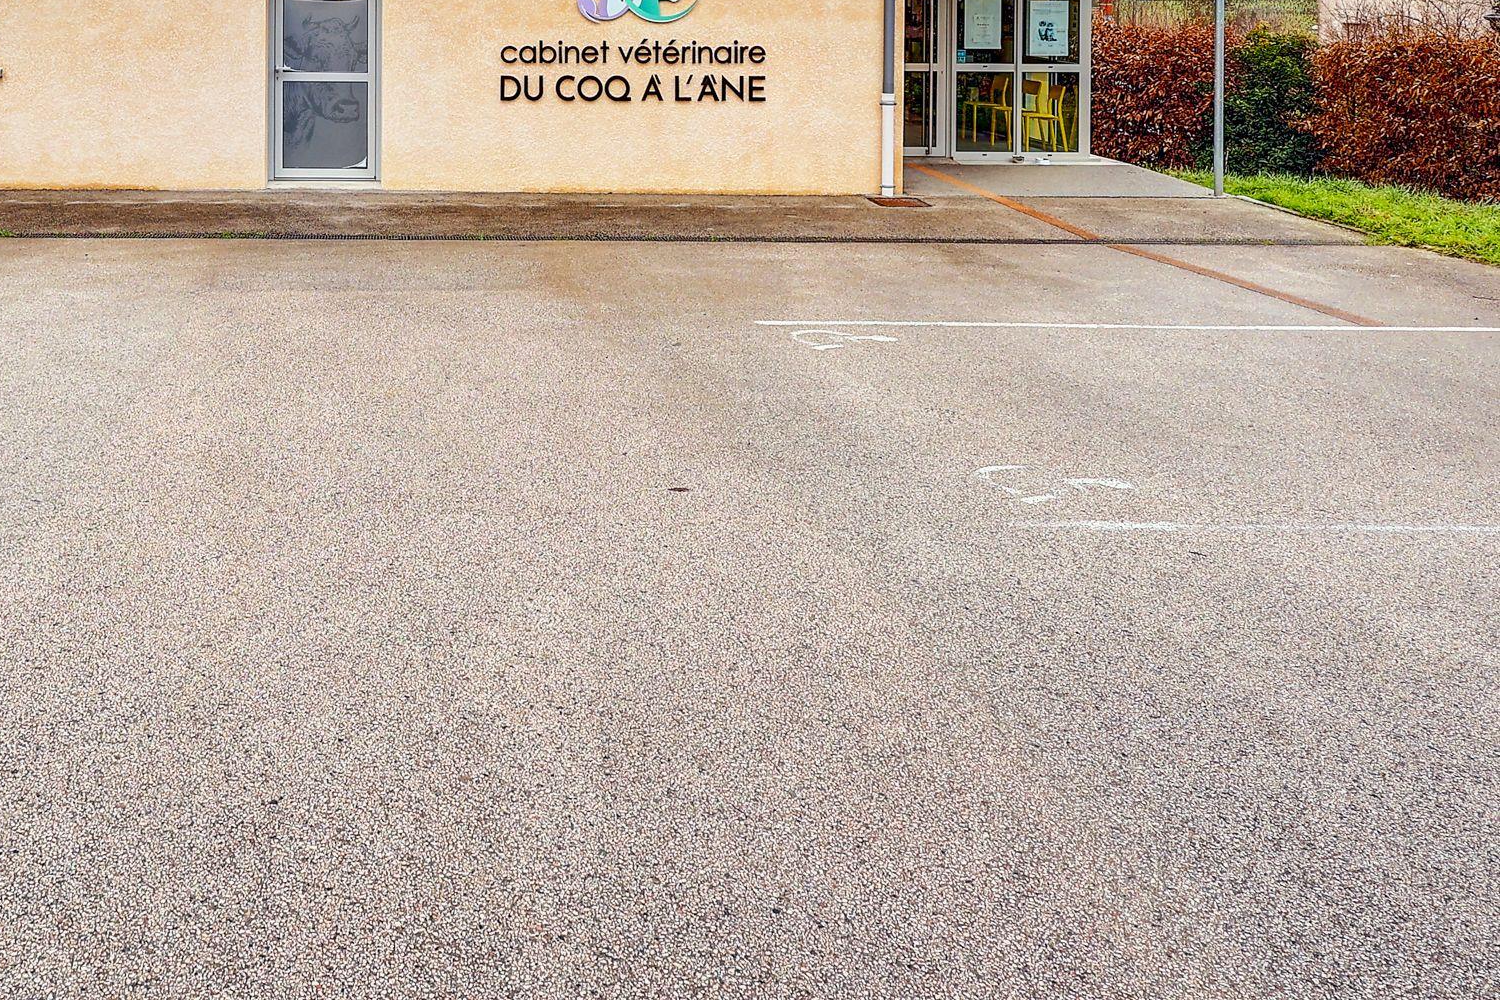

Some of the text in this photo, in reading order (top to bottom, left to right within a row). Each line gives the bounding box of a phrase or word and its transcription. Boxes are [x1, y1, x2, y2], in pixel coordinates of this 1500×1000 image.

[500, 38, 766, 64] cabinet vétérinaire
[500, 75, 544, 101] DU
[555, 75, 631, 101] COQ
